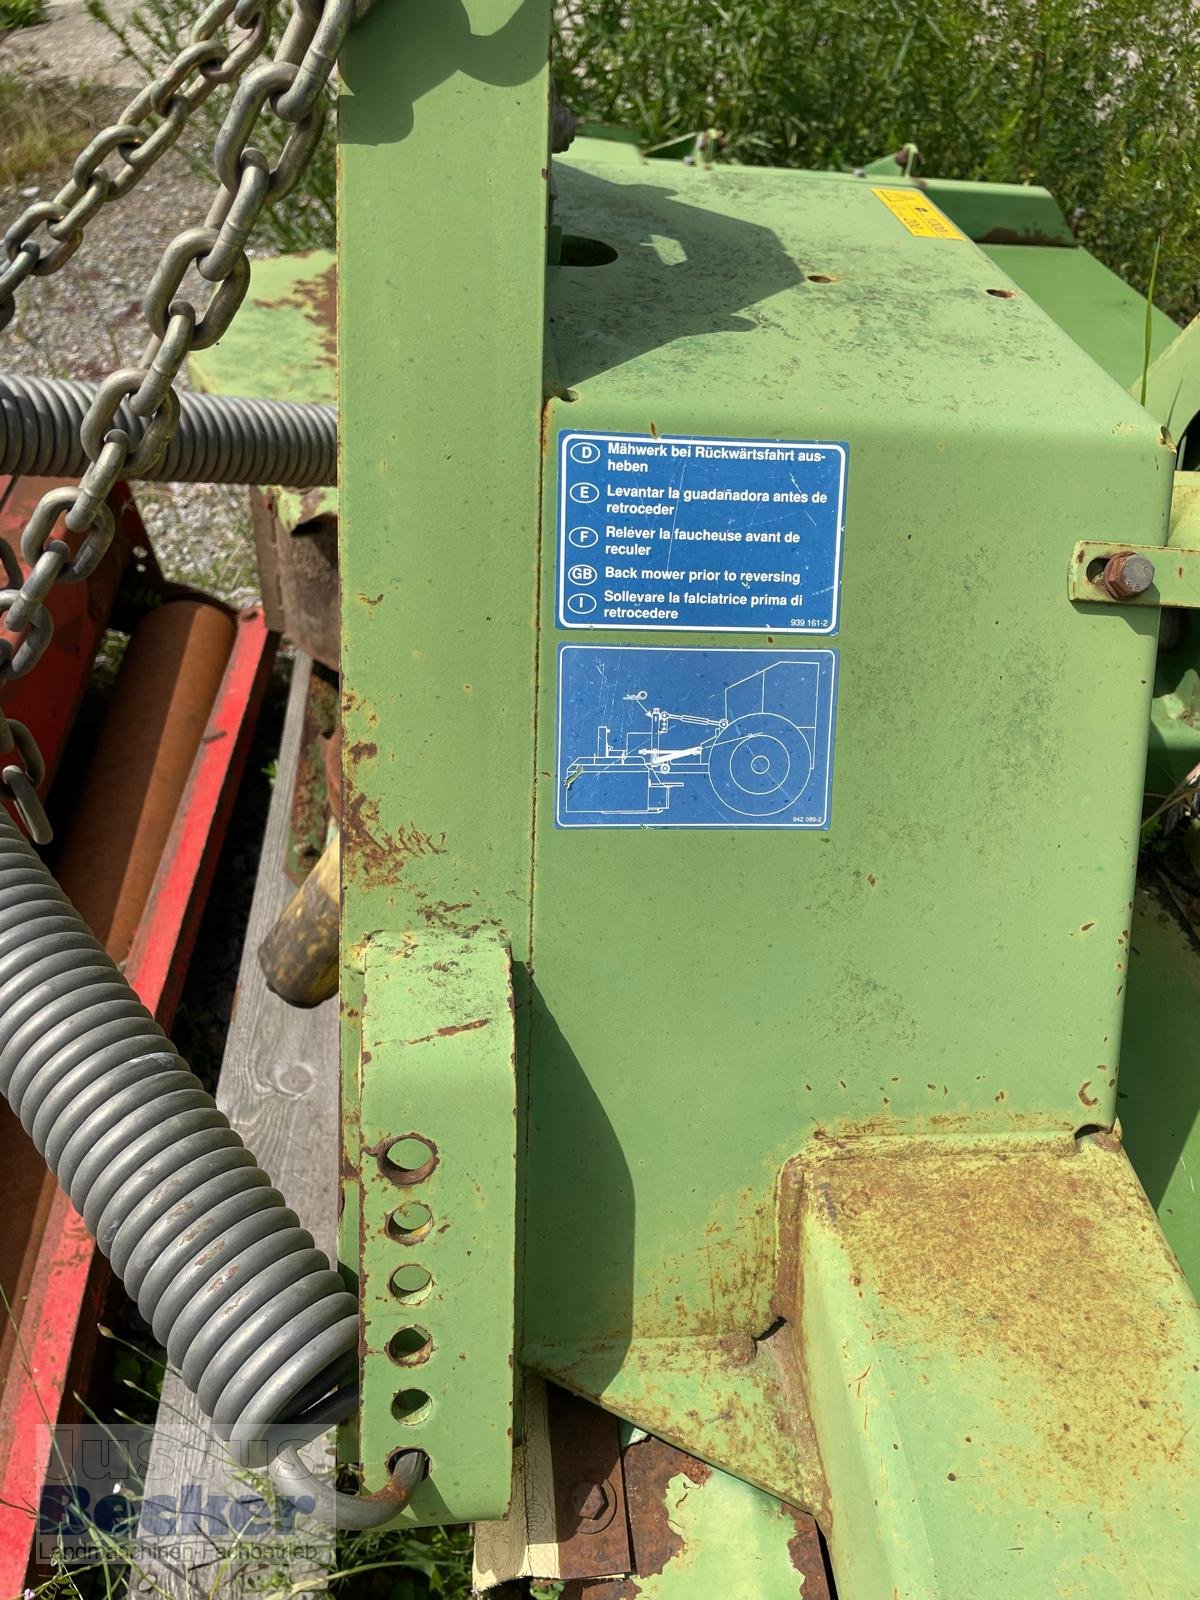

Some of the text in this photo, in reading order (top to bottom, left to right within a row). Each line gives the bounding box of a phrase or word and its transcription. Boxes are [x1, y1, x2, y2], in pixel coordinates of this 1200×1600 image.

[582, 447, 592, 458] D
[608, 442, 826, 462] Mähwerk bei Rückwärtsfahrt aus-
[607, 459, 648, 472] heben
[580, 486, 589, 498] E
[607, 484, 828, 503] Levantar la guadañadora antes de
[606, 503, 674, 515] retroceder
[580, 531, 588, 542] F
[605, 525, 800, 543] Relever la faucheuse avant de
[605, 544, 651, 555] reculer
[572, 568, 592, 579] GB
[605, 567, 801, 585] Back mower prior to reversing
[579, 597, 584, 608] I
[604, 590, 803, 608] Sollevare la falciatrice prima di
[603, 608, 679, 619] retrocedere
[790, 619, 805, 627] 939
